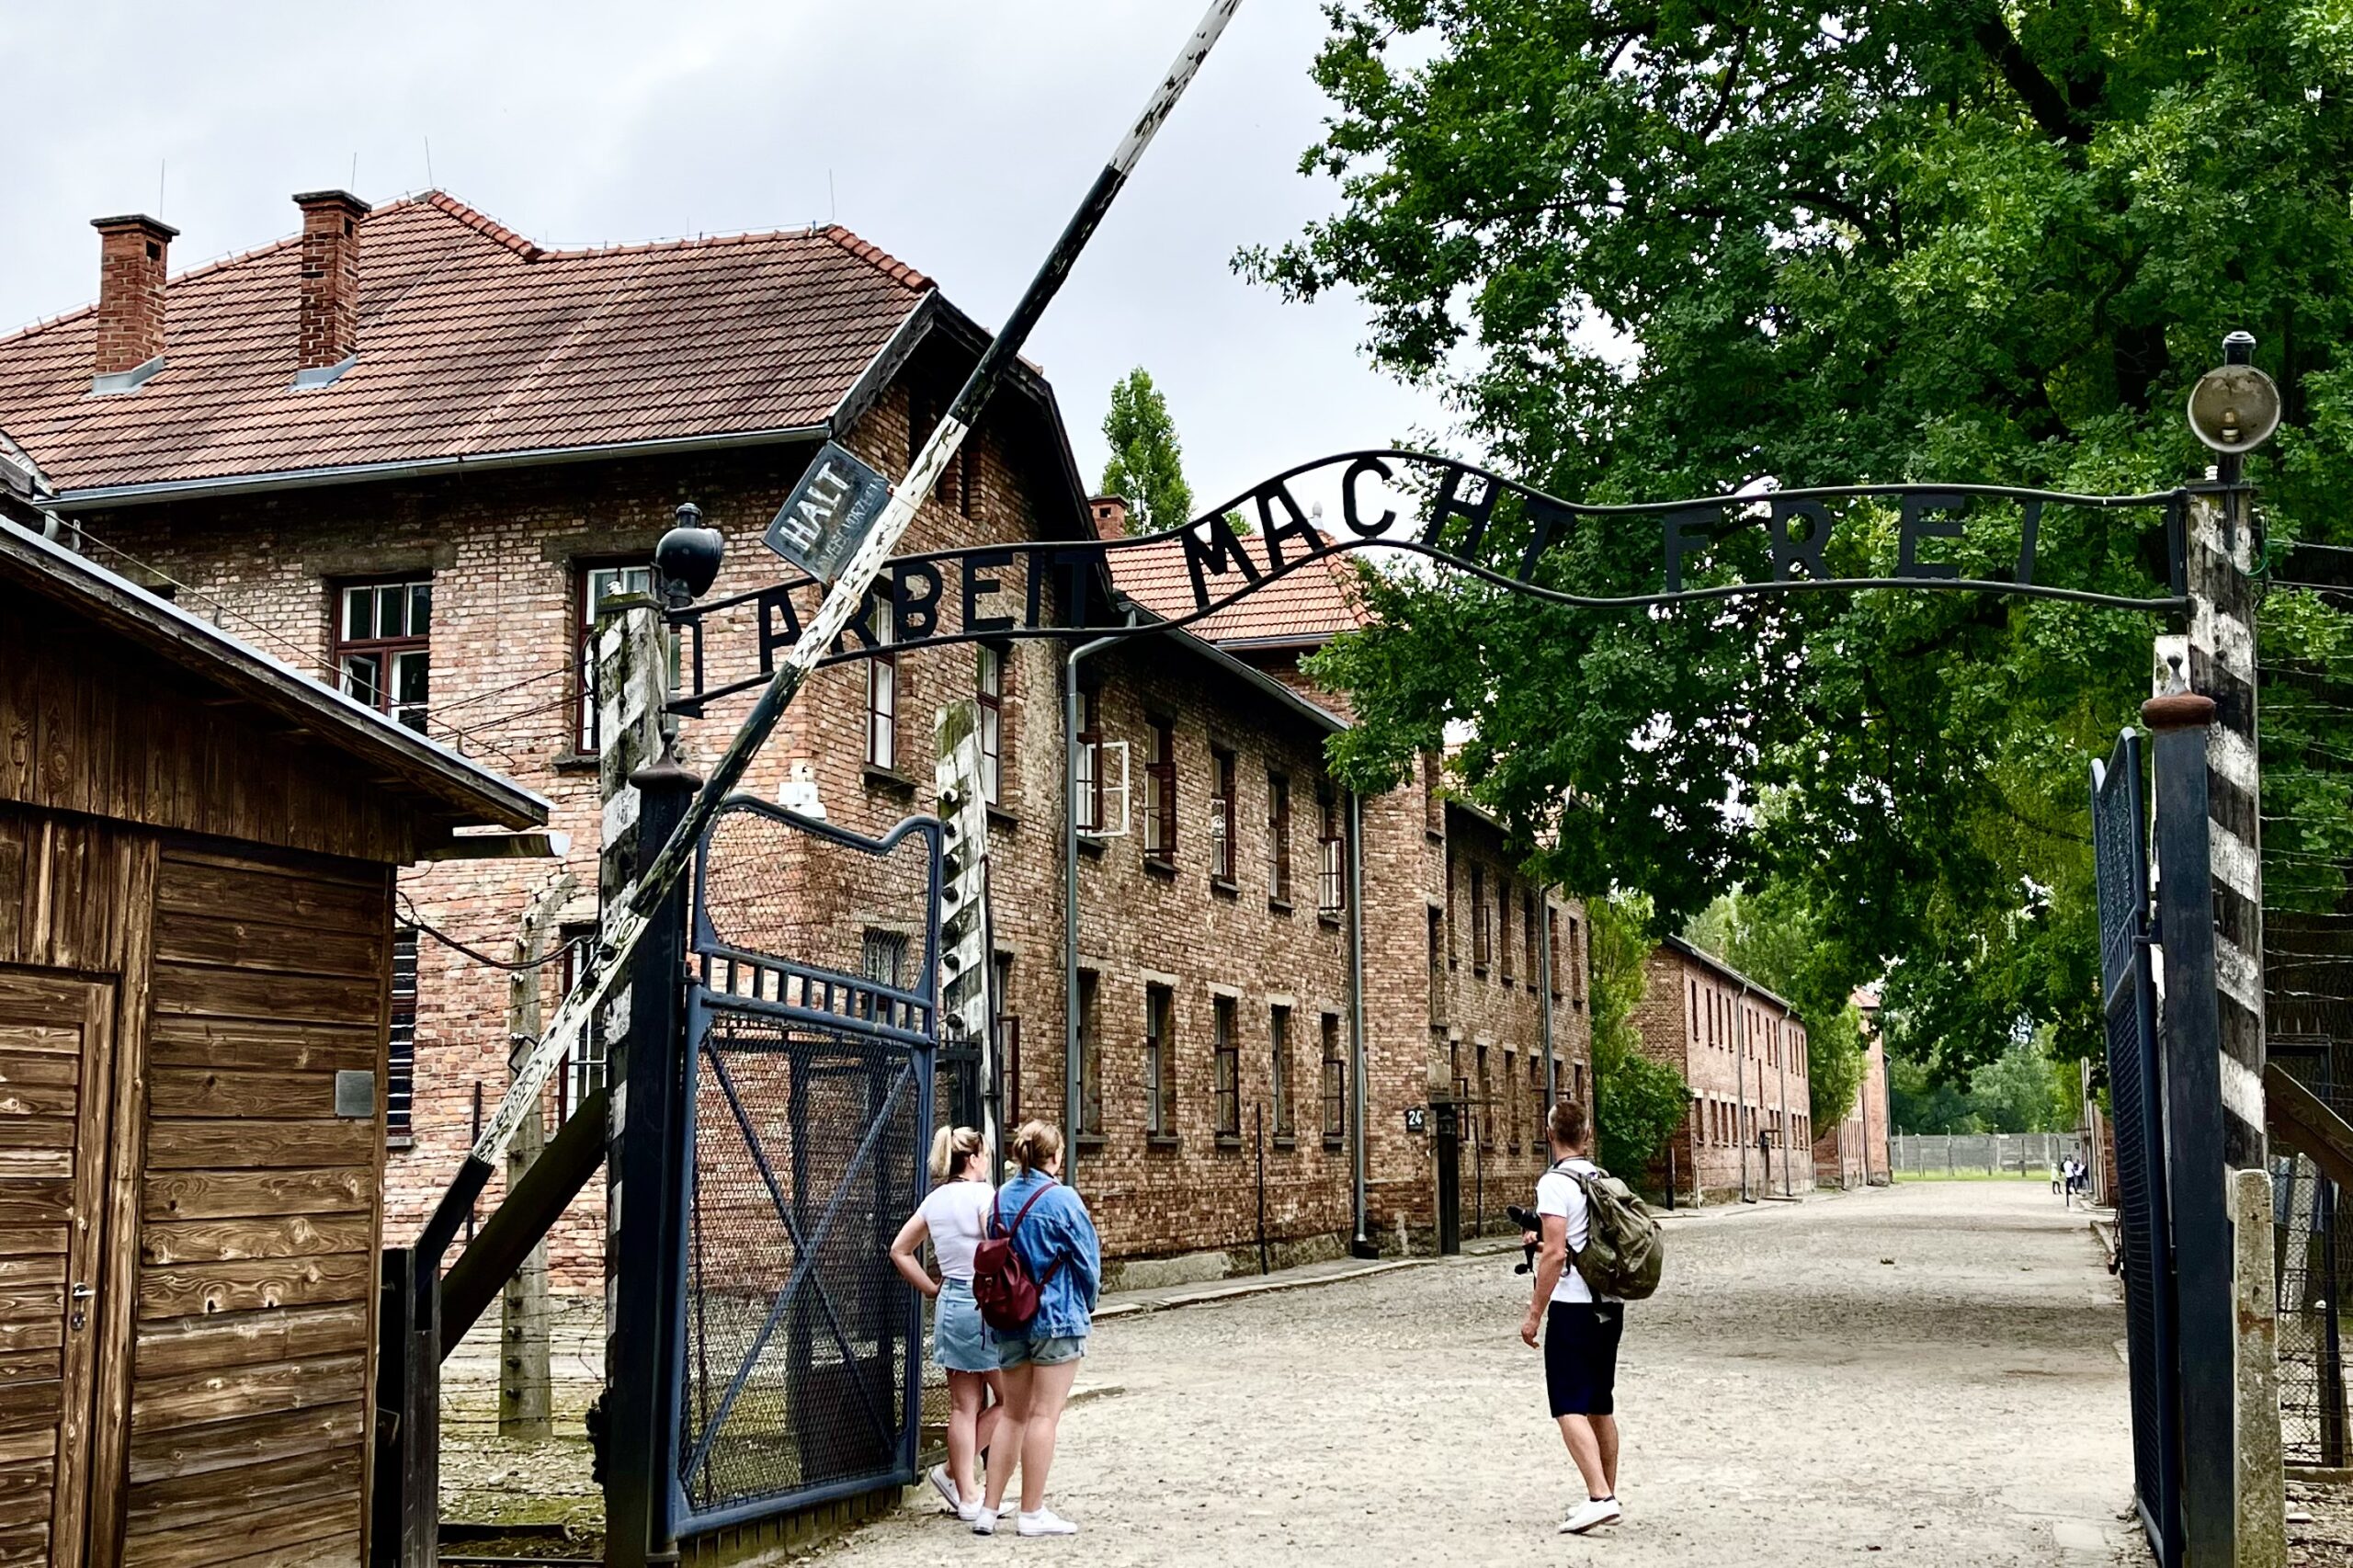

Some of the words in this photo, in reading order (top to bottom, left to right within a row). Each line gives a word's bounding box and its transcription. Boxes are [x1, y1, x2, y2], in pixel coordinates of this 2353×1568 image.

[779, 461, 850, 551] HALT
[757, 551, 1105, 674] ARBEIT
[1181, 458, 1574, 610] MACHT
[1664, 494, 2041, 594] FREI
[1408, 1109, 1424, 1126] 24
